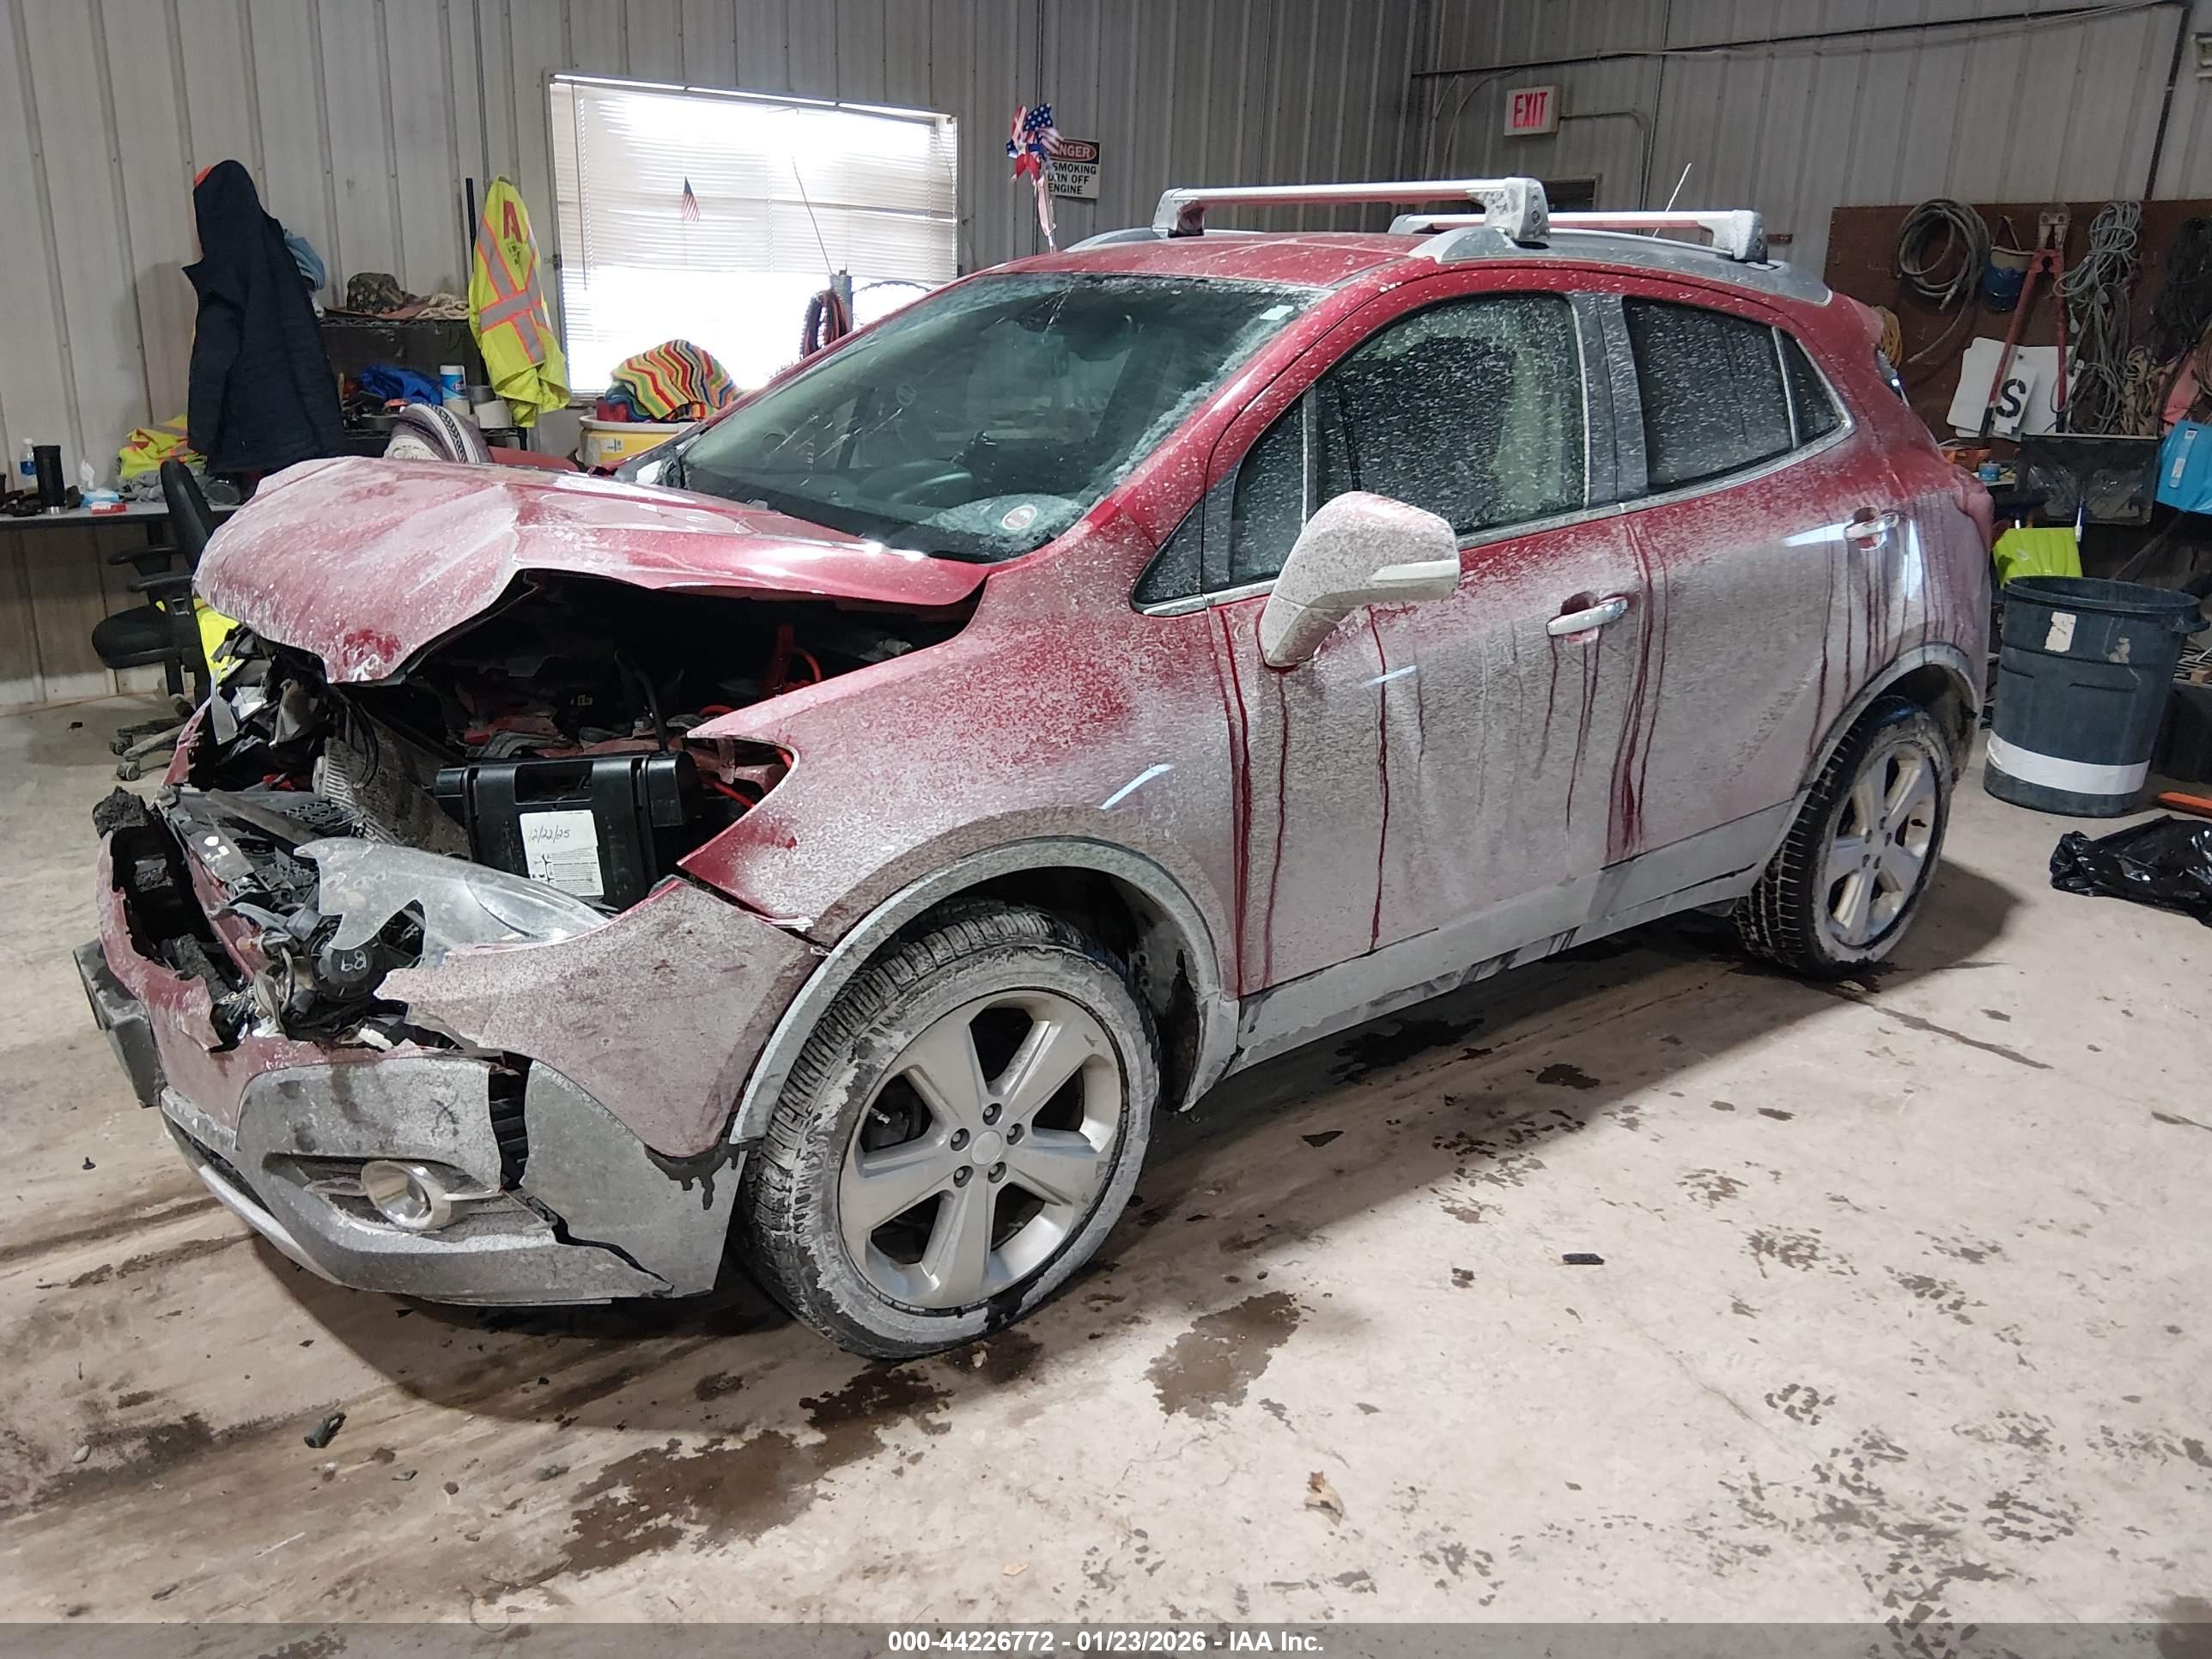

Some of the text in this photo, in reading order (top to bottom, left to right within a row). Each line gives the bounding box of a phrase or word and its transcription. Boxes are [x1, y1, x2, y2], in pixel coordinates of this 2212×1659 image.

[1514, 91, 1547, 128] EXIT
[1057, 143, 1091, 158] NGER
[1052, 161, 1097, 174] SMOKING
[1048, 172, 1090, 185] URN OFF
[1048, 182, 1083, 195] ENGINE
[1996, 378, 2027, 418] S
[528, 824, 570, 844] 12/22/25
